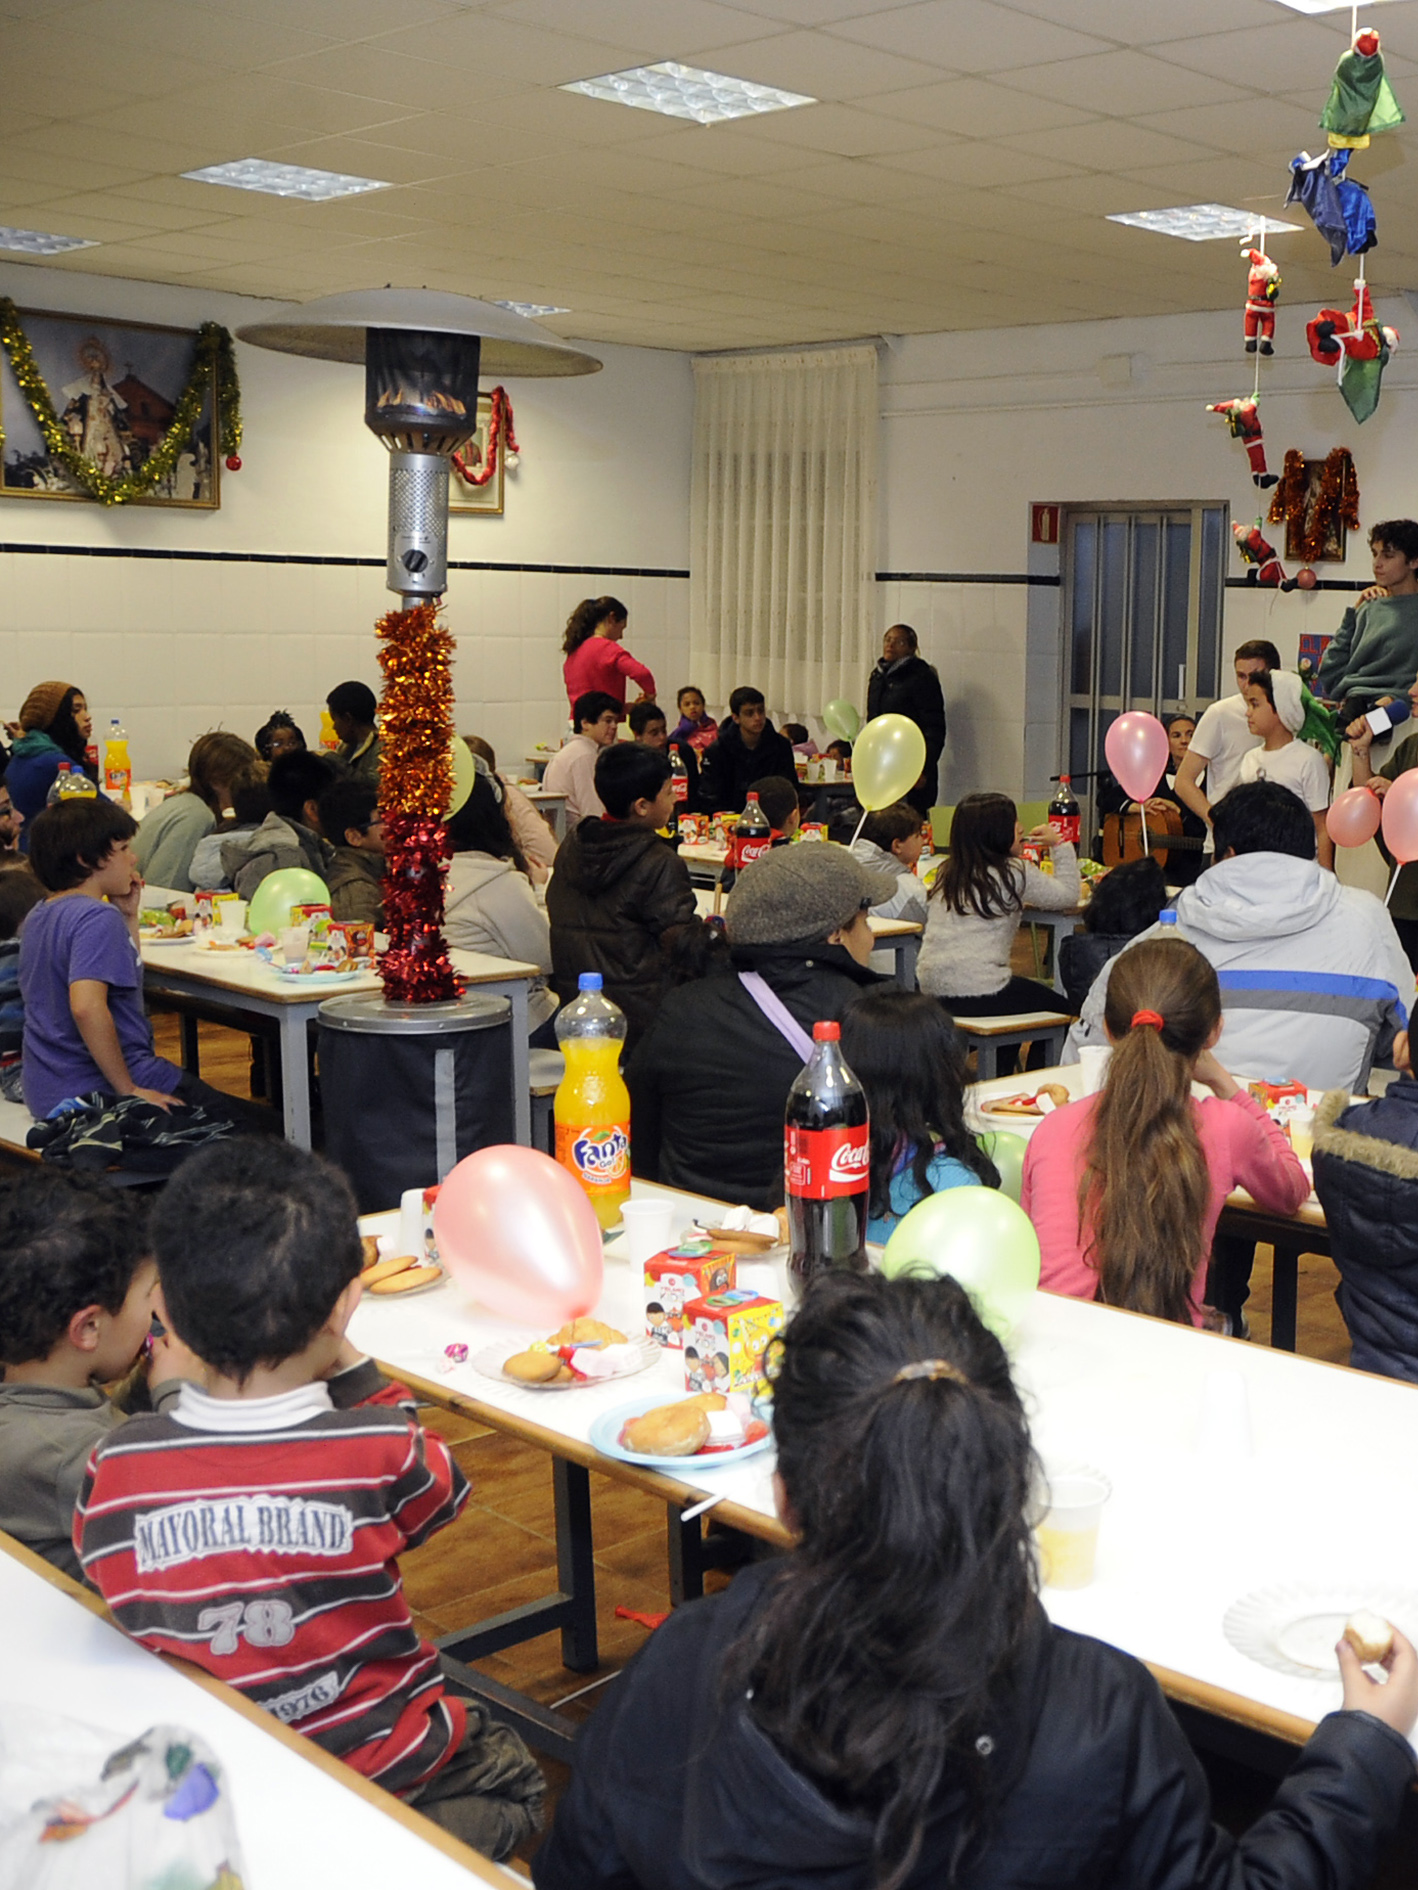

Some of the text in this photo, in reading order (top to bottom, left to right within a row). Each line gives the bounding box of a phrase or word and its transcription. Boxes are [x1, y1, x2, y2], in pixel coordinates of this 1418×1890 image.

[573, 1133, 627, 1169] Fanta
[139, 1505, 346, 1563] MAYORAL BRAND
[198, 1599, 295, 1656] 78
